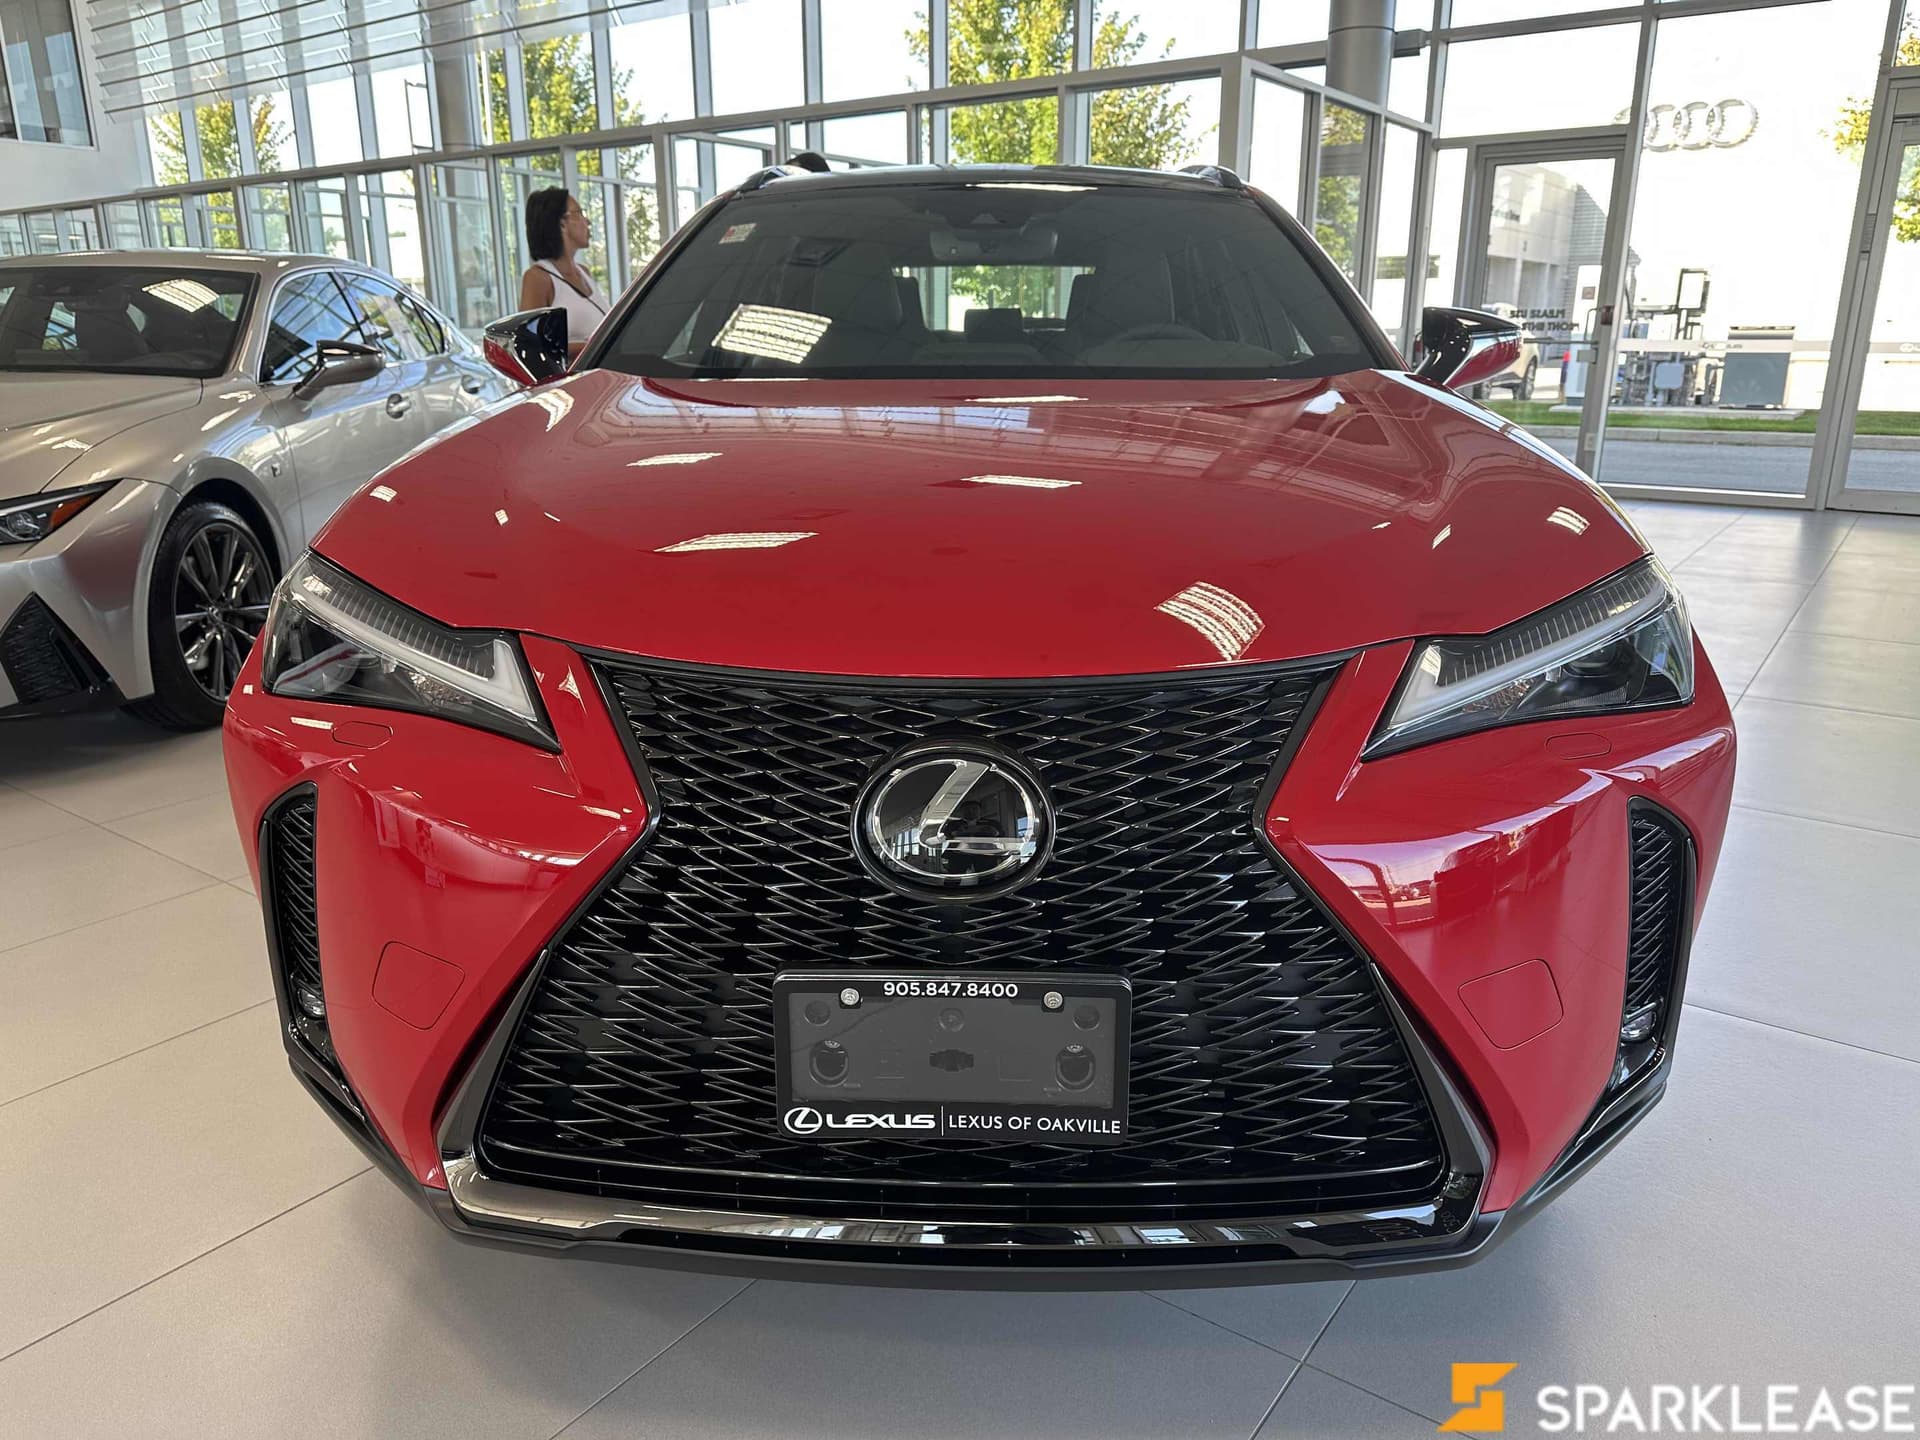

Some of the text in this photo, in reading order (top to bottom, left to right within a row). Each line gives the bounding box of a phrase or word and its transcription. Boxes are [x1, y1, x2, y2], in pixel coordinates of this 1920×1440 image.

[883, 982, 1019, 998] 905.847.8400
[826, 1113, 936, 1129] LEXUS
[948, 1114, 1121, 1134] LEXUS OF OAKVILLE
